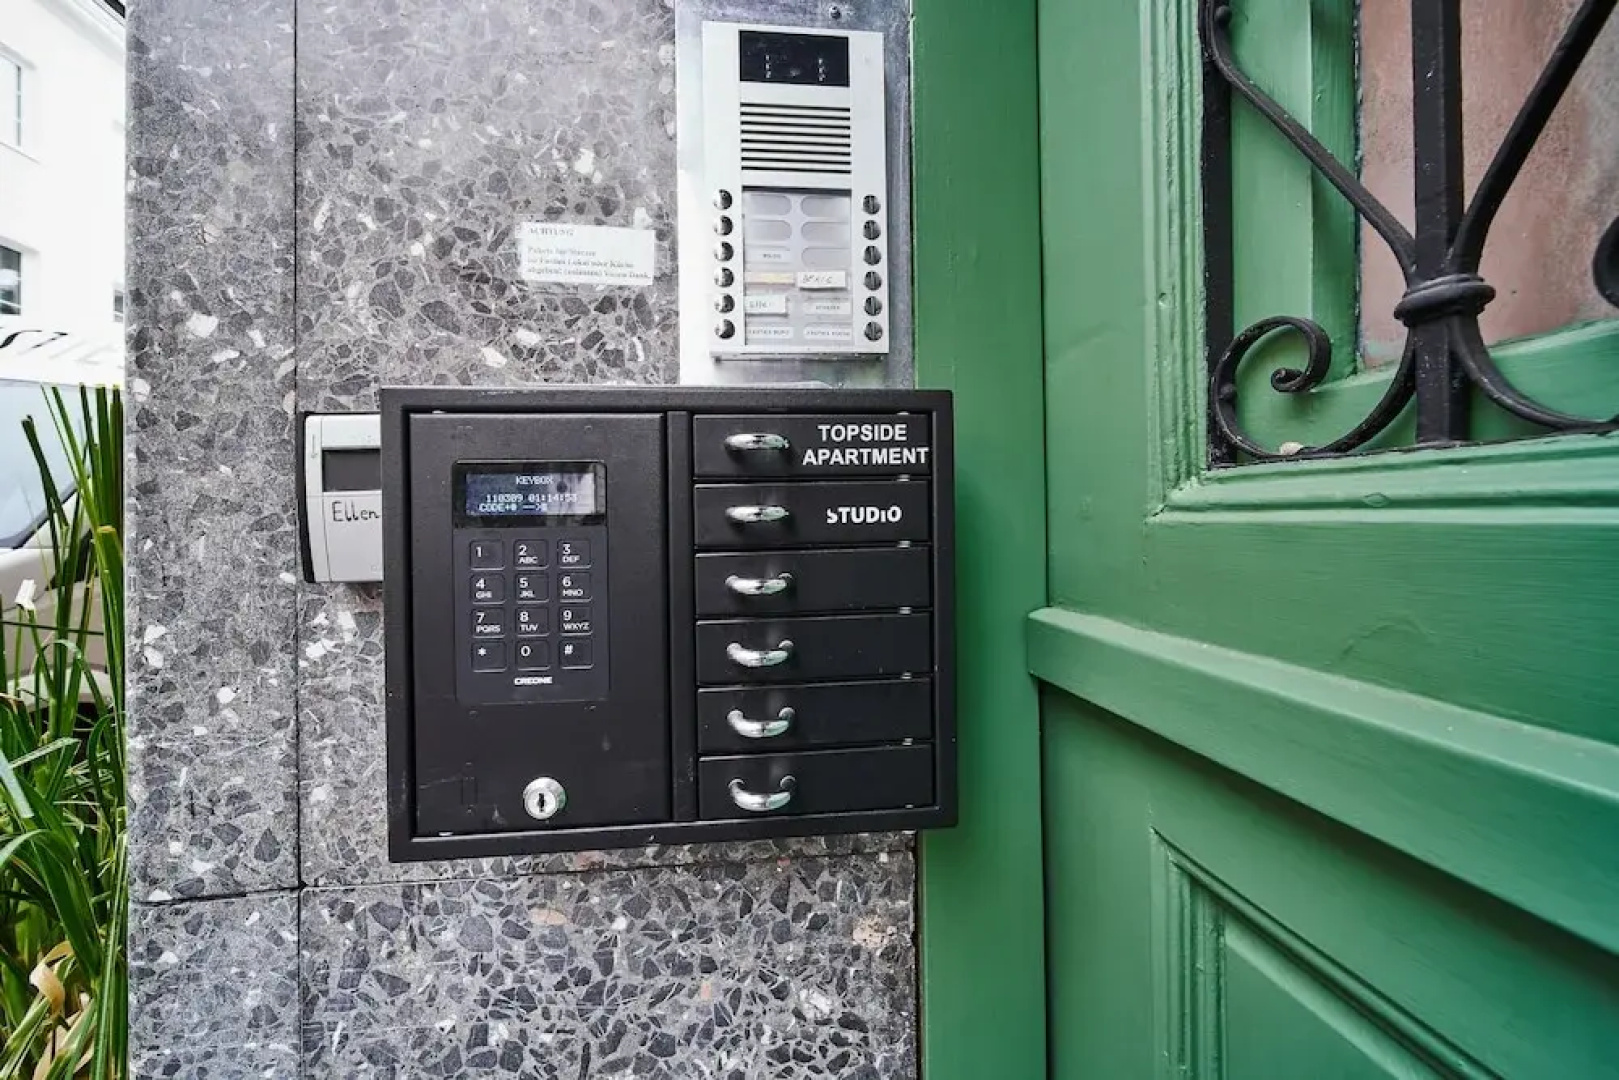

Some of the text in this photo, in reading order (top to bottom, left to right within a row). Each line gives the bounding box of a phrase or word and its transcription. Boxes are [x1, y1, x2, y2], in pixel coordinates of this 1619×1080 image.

[817, 423, 907, 442] TOPSIDE
[802, 447, 929, 466] APARTMENT
[516, 475, 554, 485] KEYBOX
[332, 501, 381, 522] Ellen
[475, 546, 482, 558] 1
[518, 545, 527, 556] 2
[562, 543, 571, 555] 3
[518, 556, 538, 564] ABC
[562, 555, 580, 564] DEF
[475, 577, 485, 589] 4
[519, 576, 528, 588] 5
[562, 576, 571, 587] 6
[475, 590, 493, 599] GHI
[562, 588, 583, 597] MNO
[476, 612, 485, 624] 7
[520, 611, 529, 622] 8
[563, 610, 572, 621] 9
[476, 625, 501, 633] PQRS
[520, 624, 538, 632] TUV
[563, 622, 590, 631] WXYZ
[520, 645, 532, 657] 0
